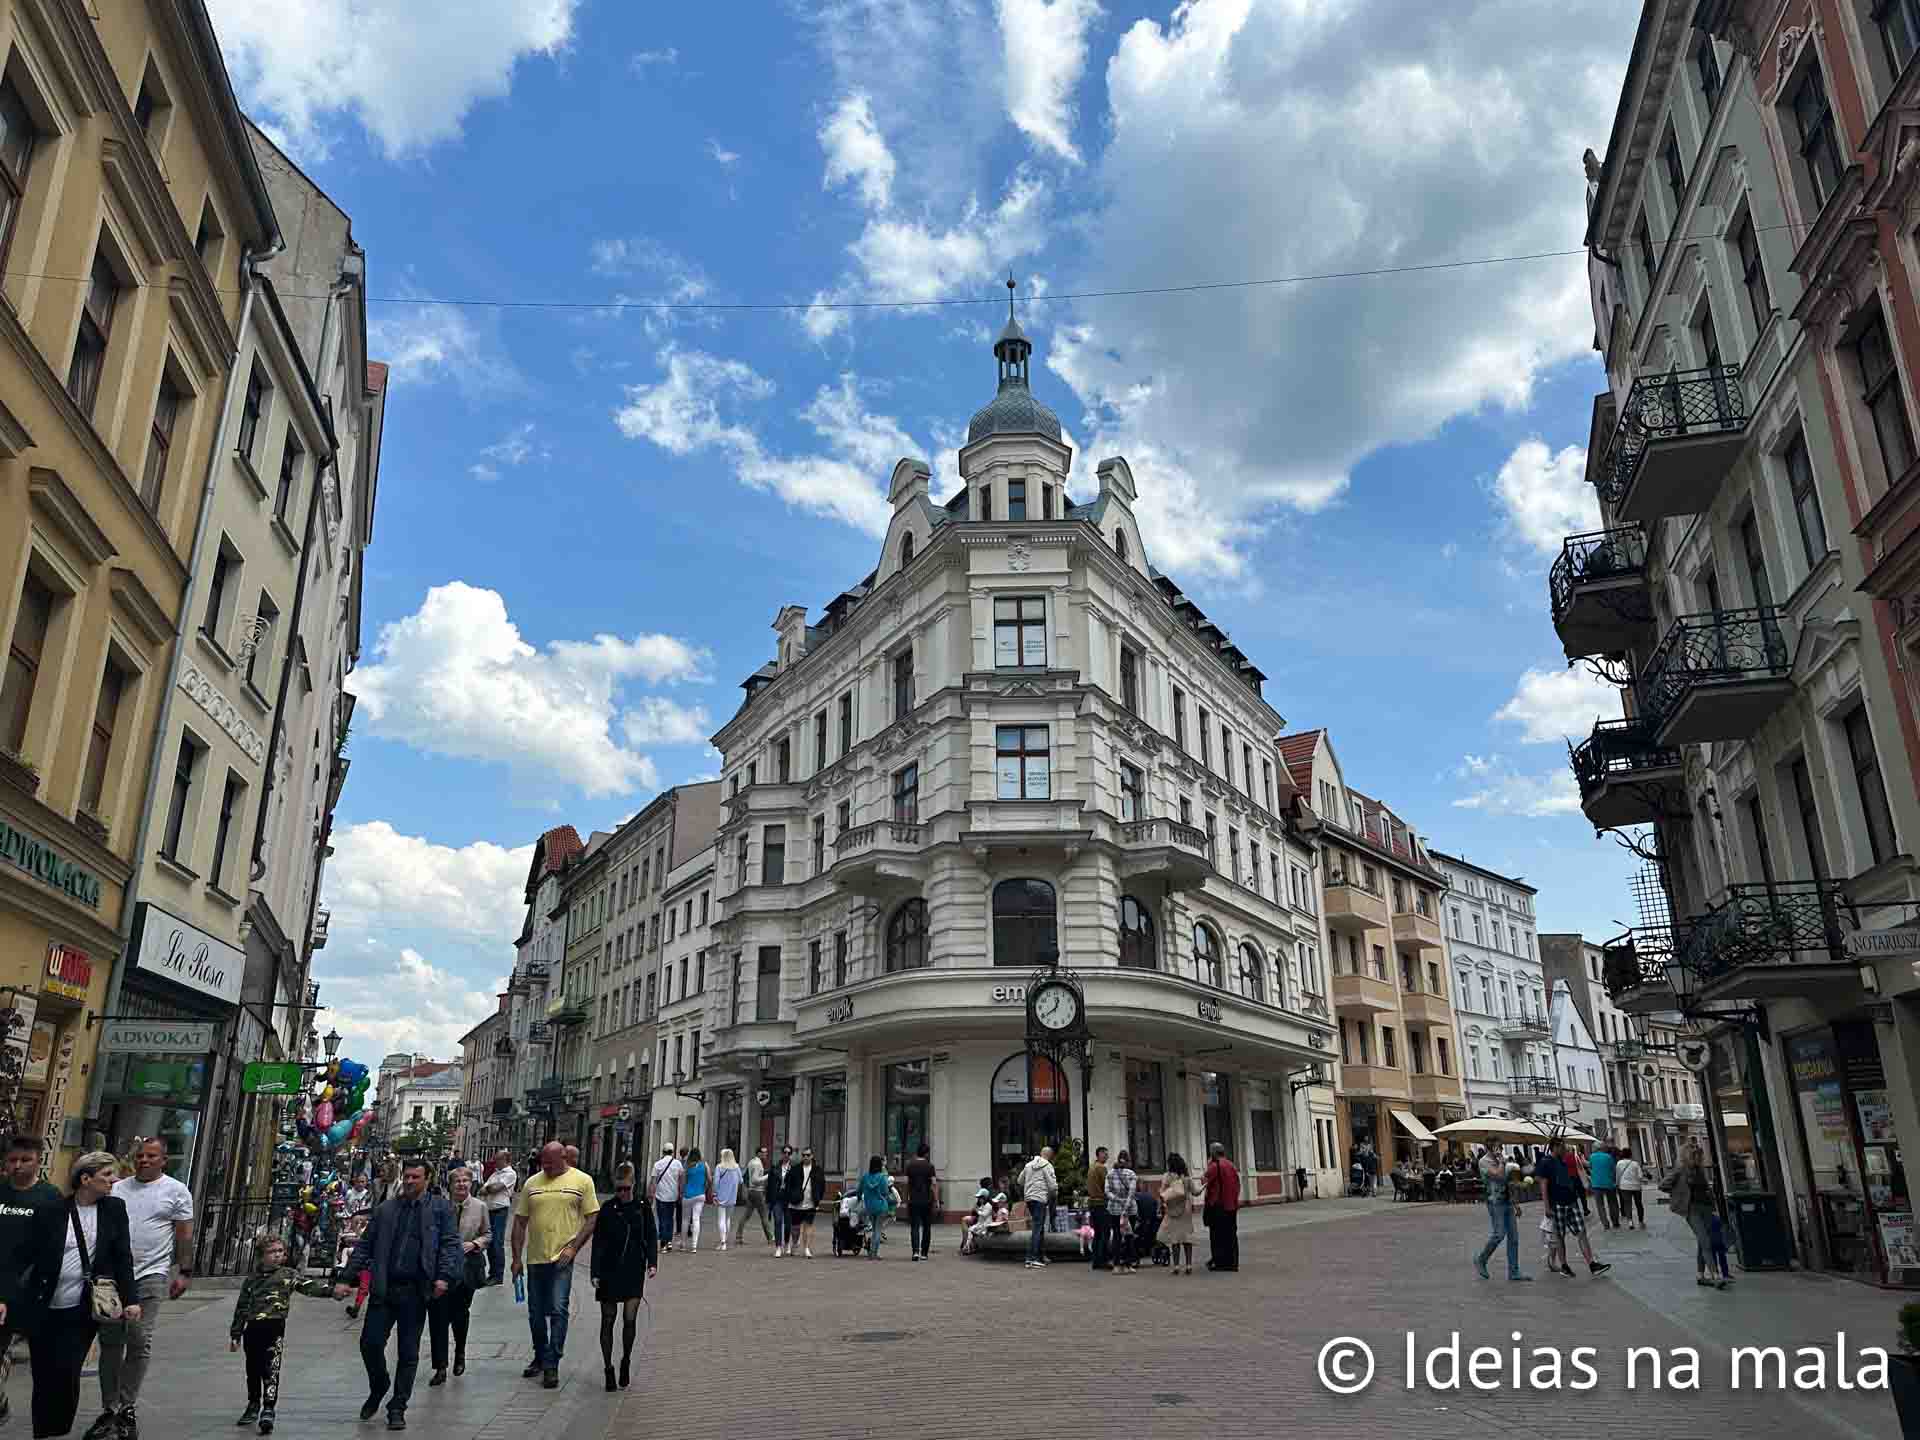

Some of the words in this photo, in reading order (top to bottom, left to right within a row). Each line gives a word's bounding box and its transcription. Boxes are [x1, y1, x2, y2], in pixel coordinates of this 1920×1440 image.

[162, 929, 185, 972] La
[188, 942, 225, 989] Rosa
[826, 996, 854, 1022] empik
[110, 1030, 203, 1046] ADWOKAT
